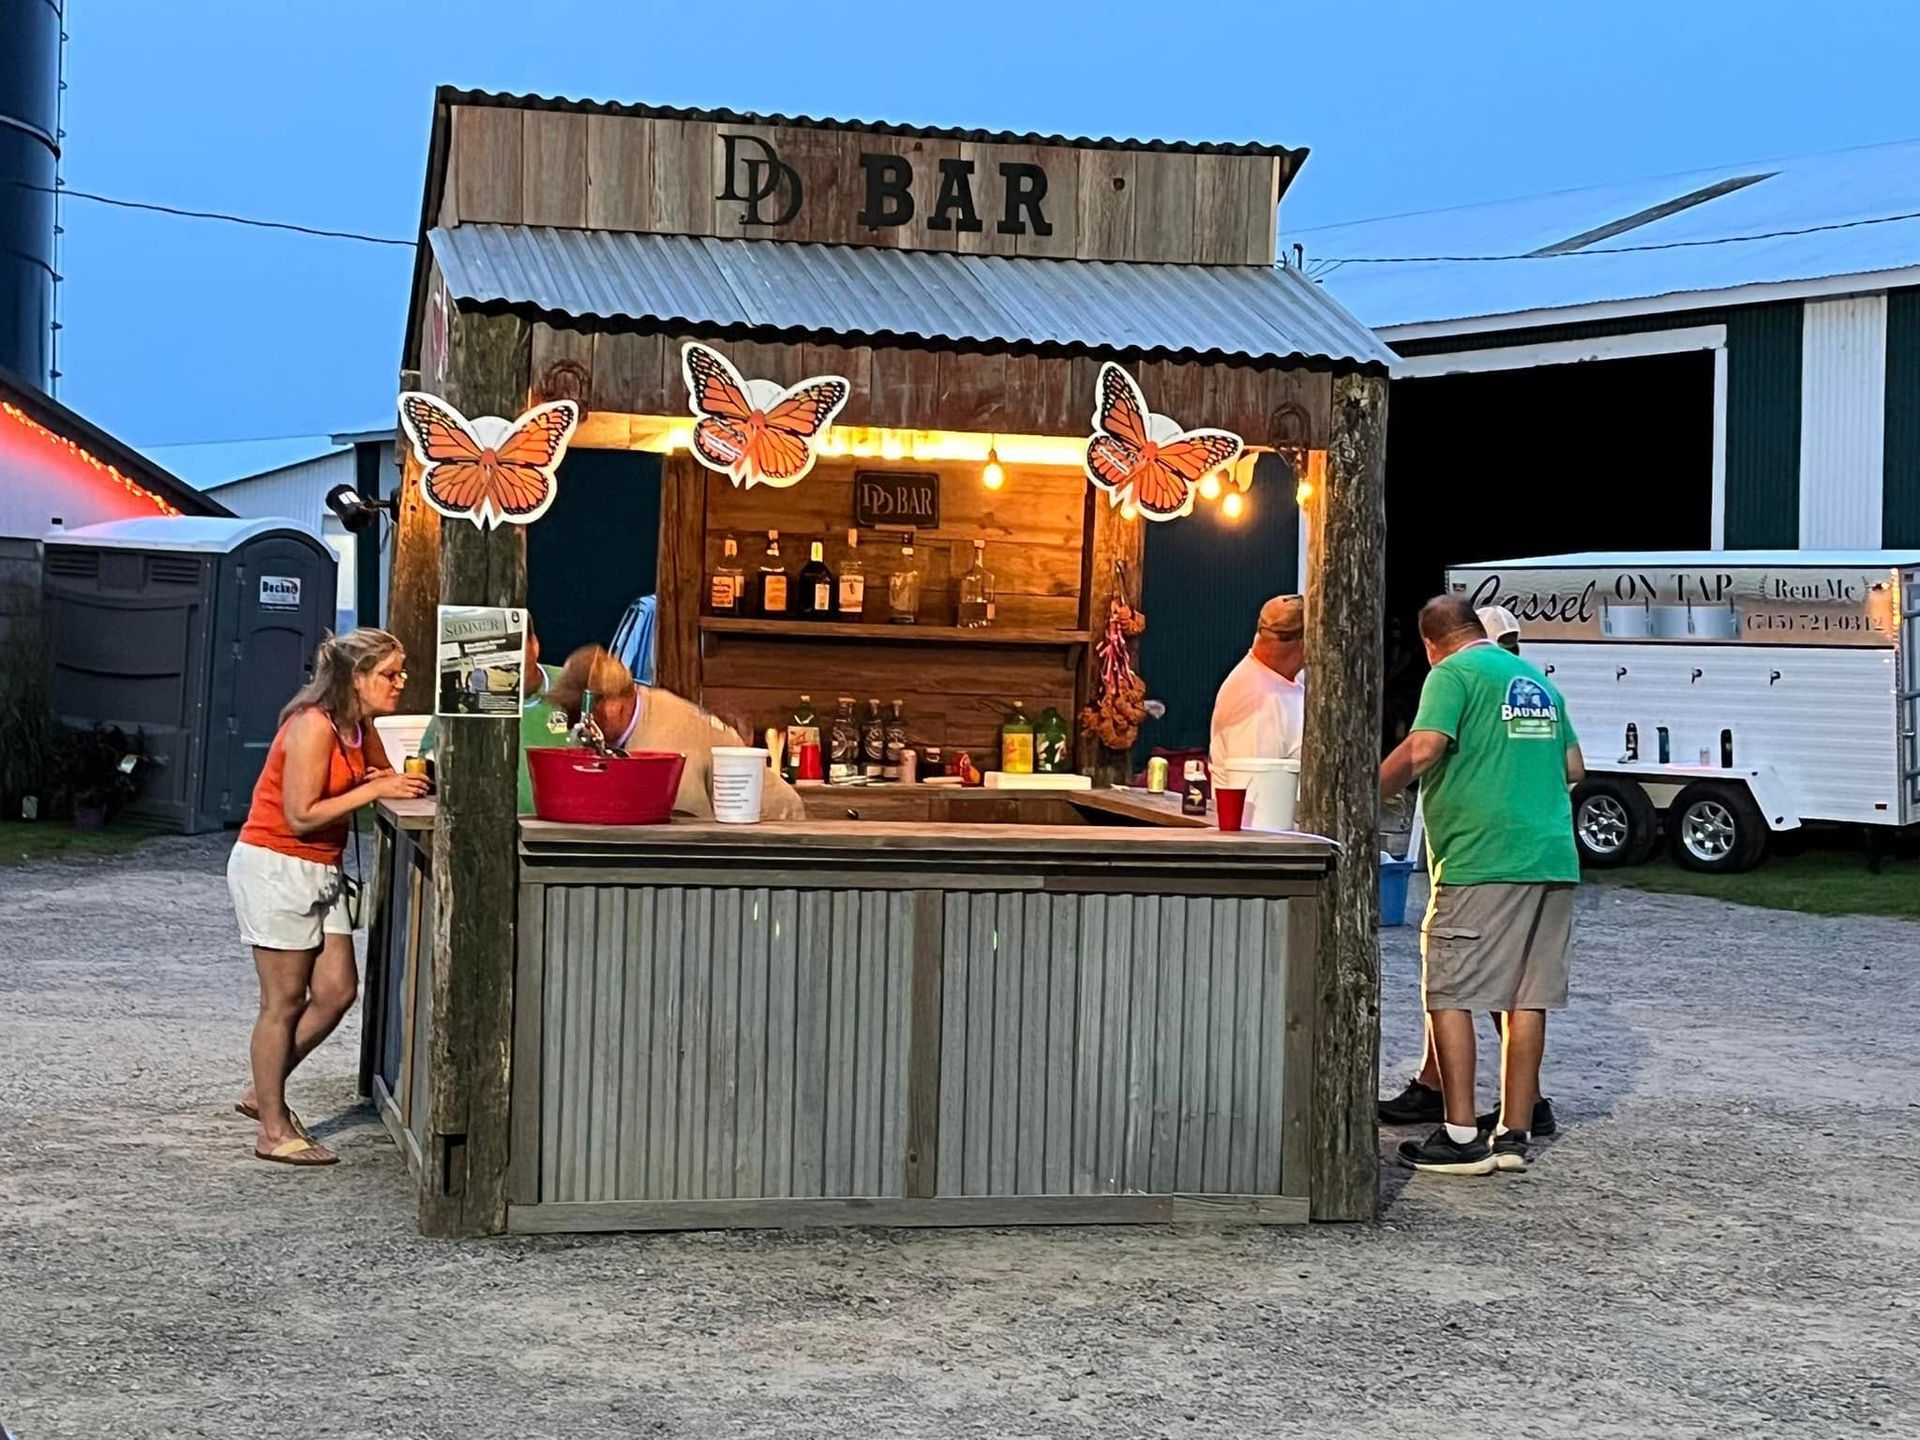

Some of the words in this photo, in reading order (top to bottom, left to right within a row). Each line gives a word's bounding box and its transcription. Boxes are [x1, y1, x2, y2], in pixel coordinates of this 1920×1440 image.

[857, 152, 1054, 237] BAR
[896, 486, 933, 516] BAR
[1470, 574, 1597, 624] Cassel
[1614, 573, 1657, 601] ON
[1669, 573, 1733, 602] TAP
[1774, 578, 1820, 599] Rent
[1826, 578, 1856, 599] Me
[1746, 614, 1794, 631] (715)
